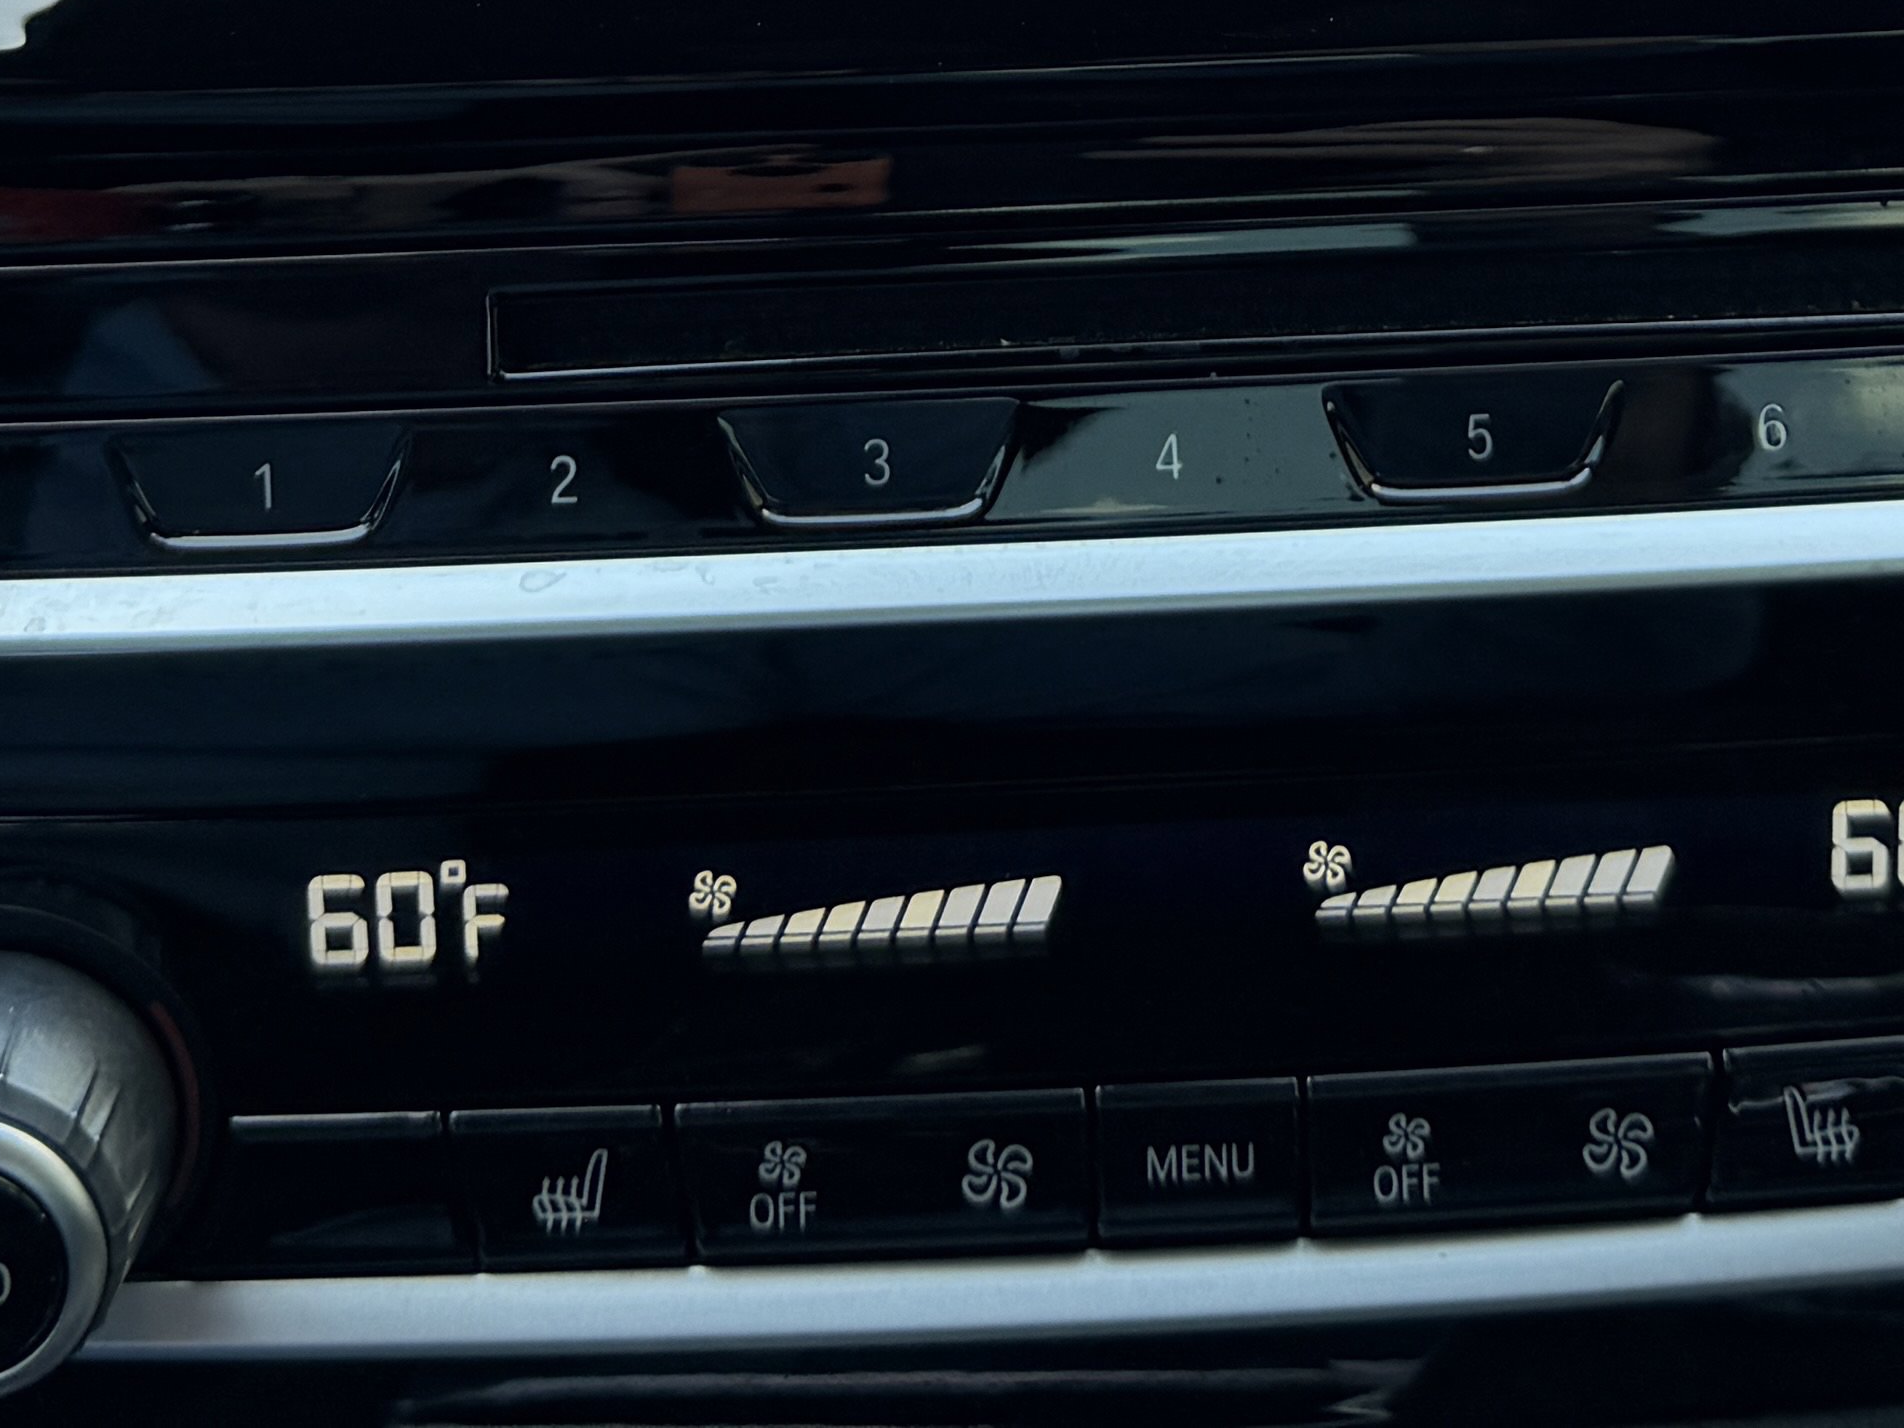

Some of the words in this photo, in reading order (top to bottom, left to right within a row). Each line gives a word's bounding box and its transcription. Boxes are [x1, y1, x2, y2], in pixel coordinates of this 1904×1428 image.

[253, 462, 275, 510] 1
[549, 455, 578, 505] 2
[863, 438, 891, 486] 3
[1154, 431, 1183, 480] 4
[1467, 412, 1494, 461] 5
[1758, 403, 1788, 452] 6
[1146, 1144, 1256, 1188] MENU
[1374, 1164, 1442, 1205] OFF
[749, 1191, 818, 1234] OFF
